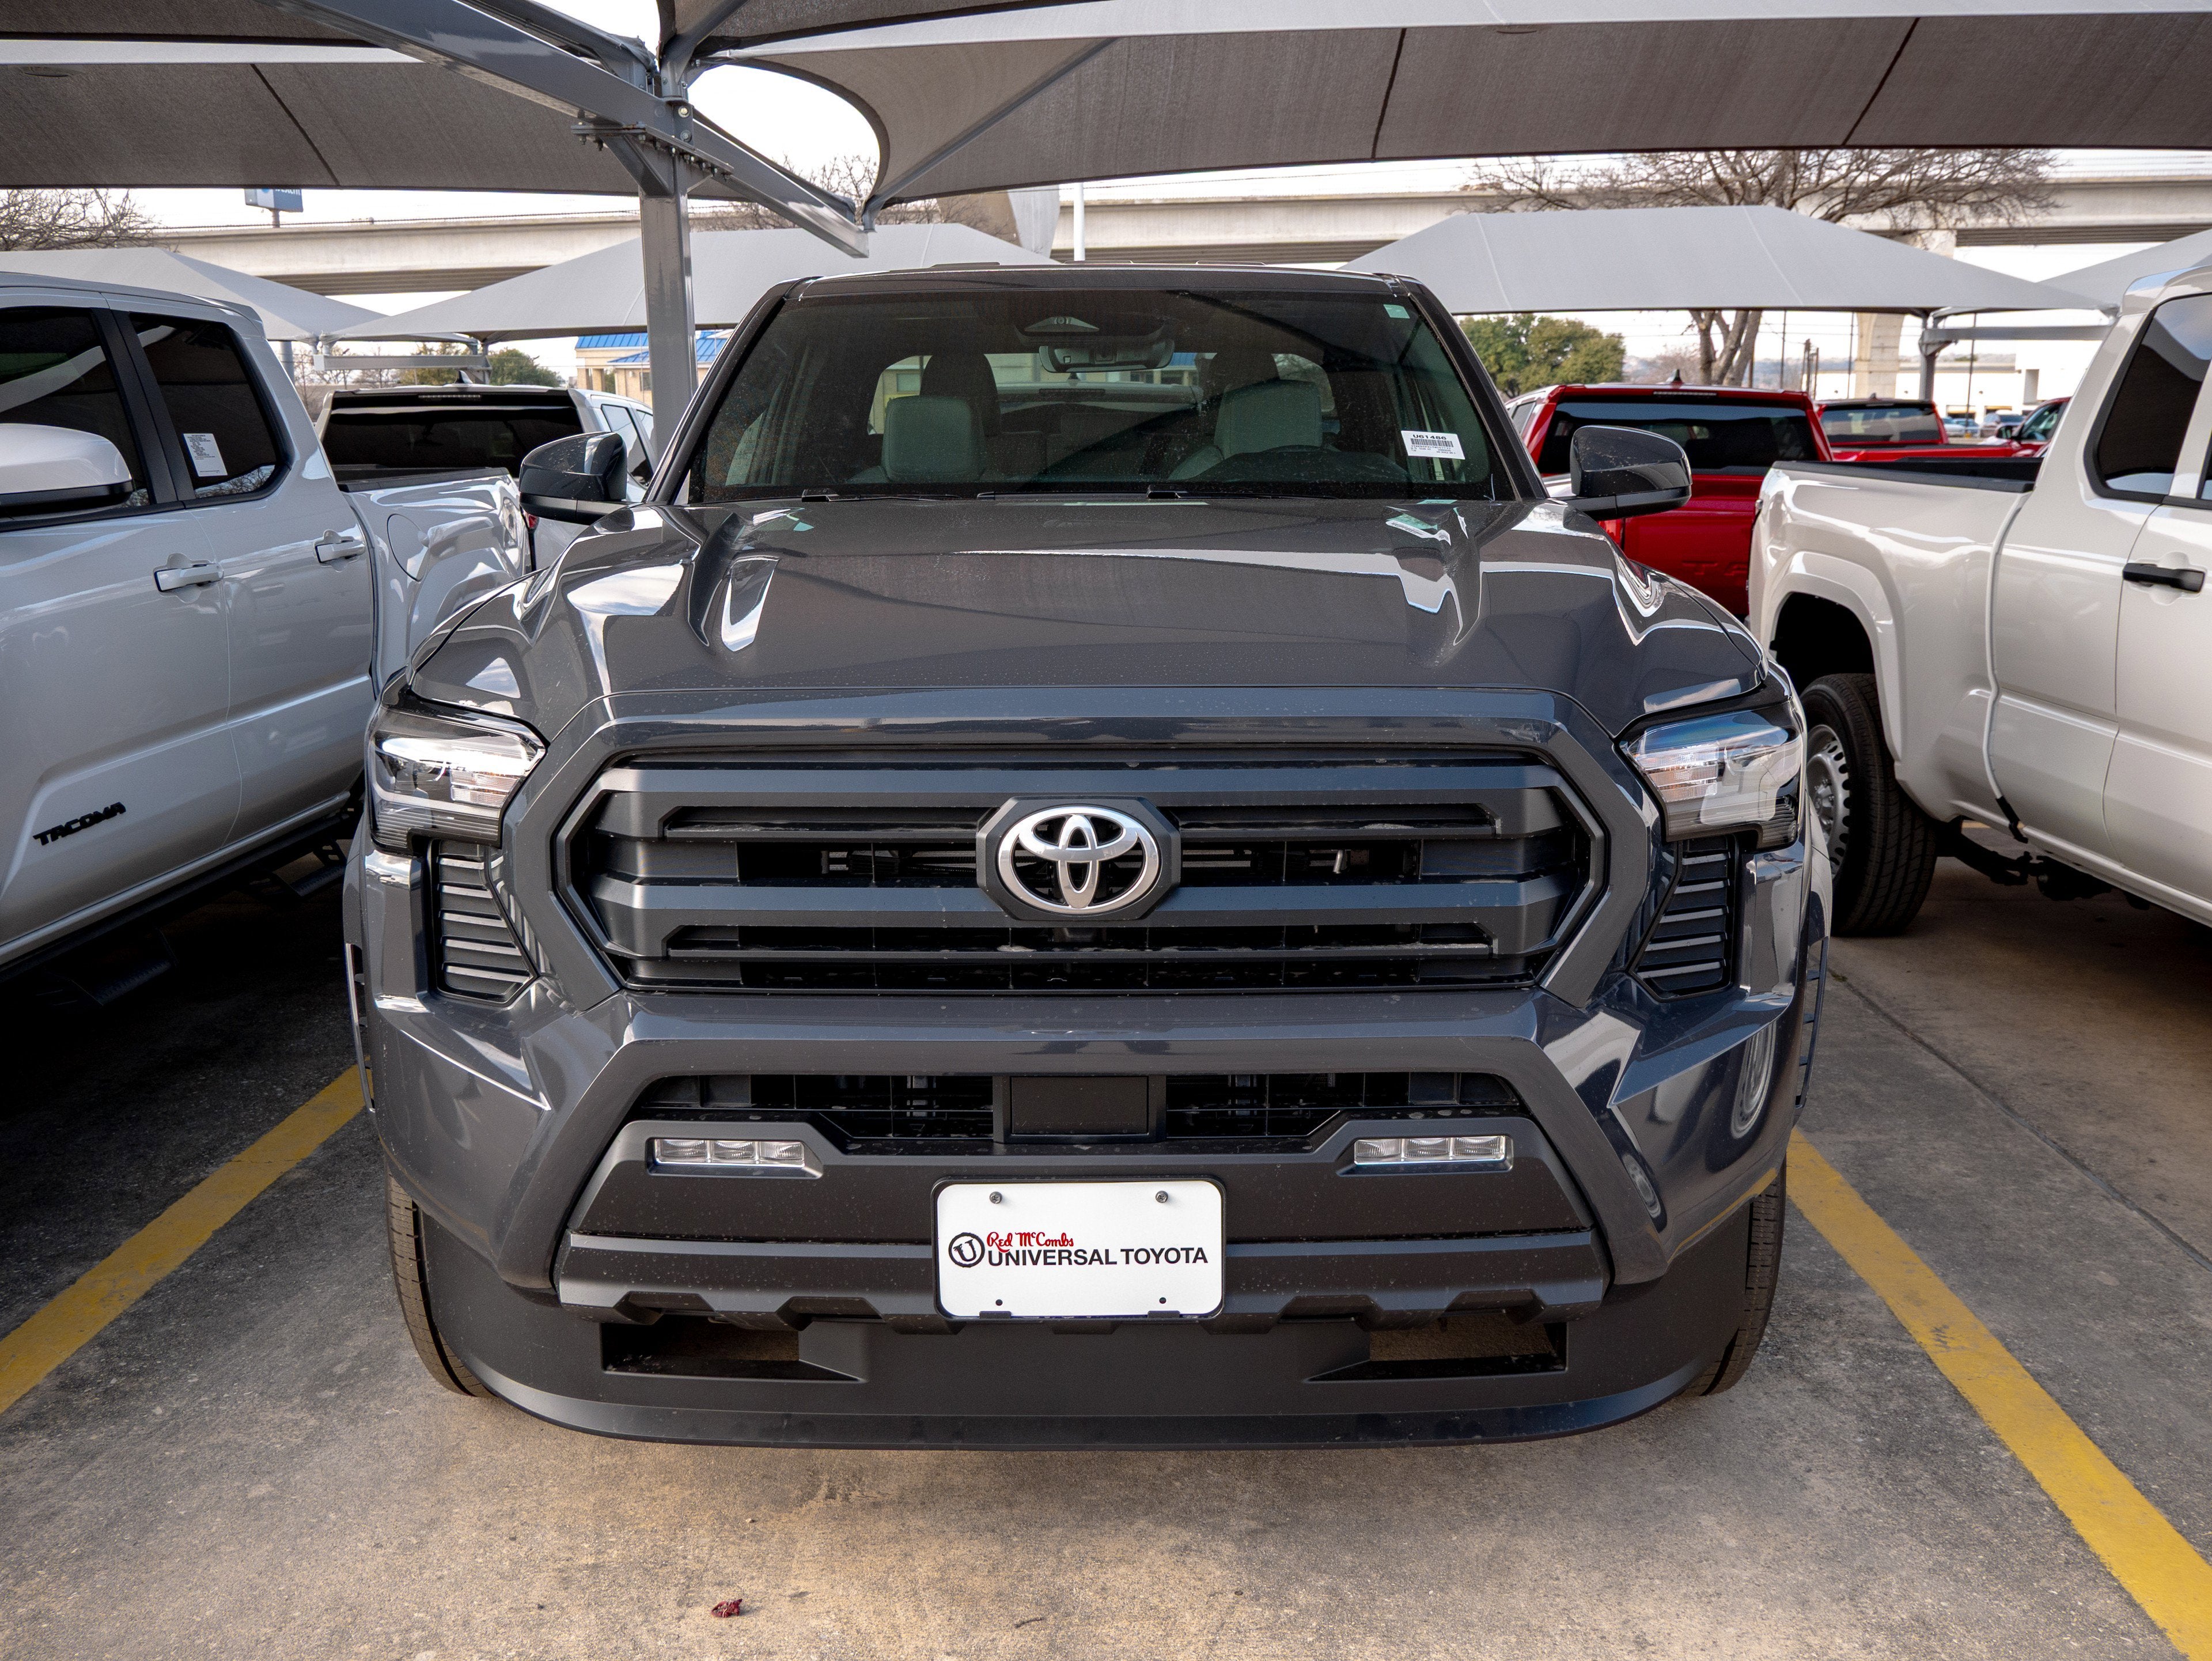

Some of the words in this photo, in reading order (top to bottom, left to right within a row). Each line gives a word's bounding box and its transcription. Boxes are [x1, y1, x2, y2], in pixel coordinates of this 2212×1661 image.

[32, 801, 127, 846] TACOMA
[986, 1231, 1013, 1253] Red
[1015, 1231, 1074, 1247] McCombs
[988, 1248, 1118, 1266] UNIVERSAL
[1120, 1247, 1209, 1265] TOYOTA
